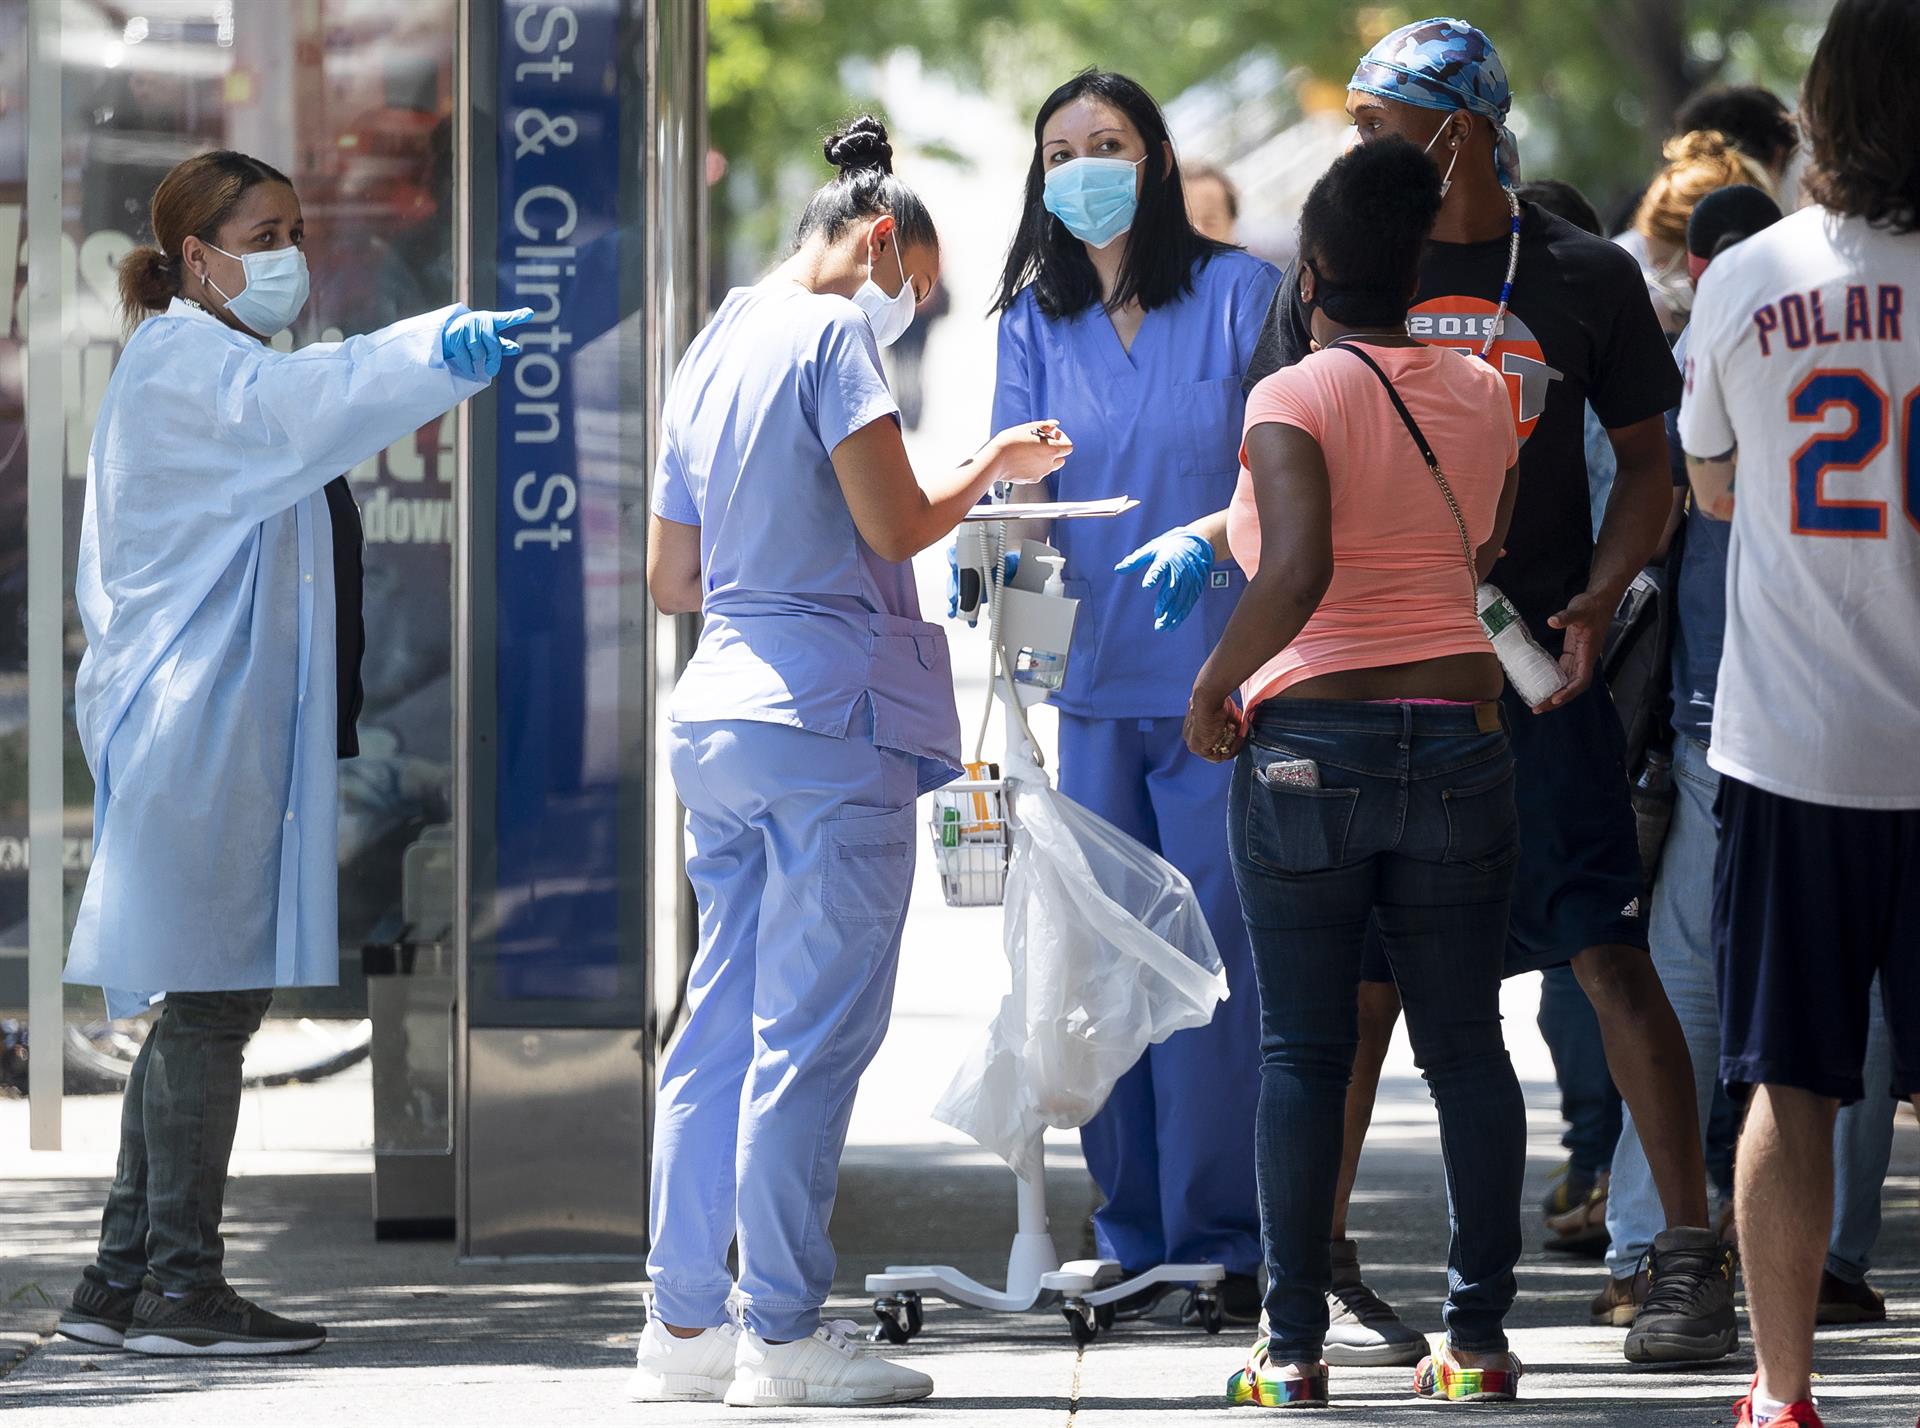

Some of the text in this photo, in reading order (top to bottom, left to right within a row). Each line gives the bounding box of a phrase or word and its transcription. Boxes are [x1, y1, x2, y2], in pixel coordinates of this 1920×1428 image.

[512, 5, 579, 550] St & Clinton St
[1410, 316, 1505, 336] 2019
[1753, 284, 1903, 356] POLAR
[1787, 368, 1920, 539] 2
[366, 487, 453, 543] dow
